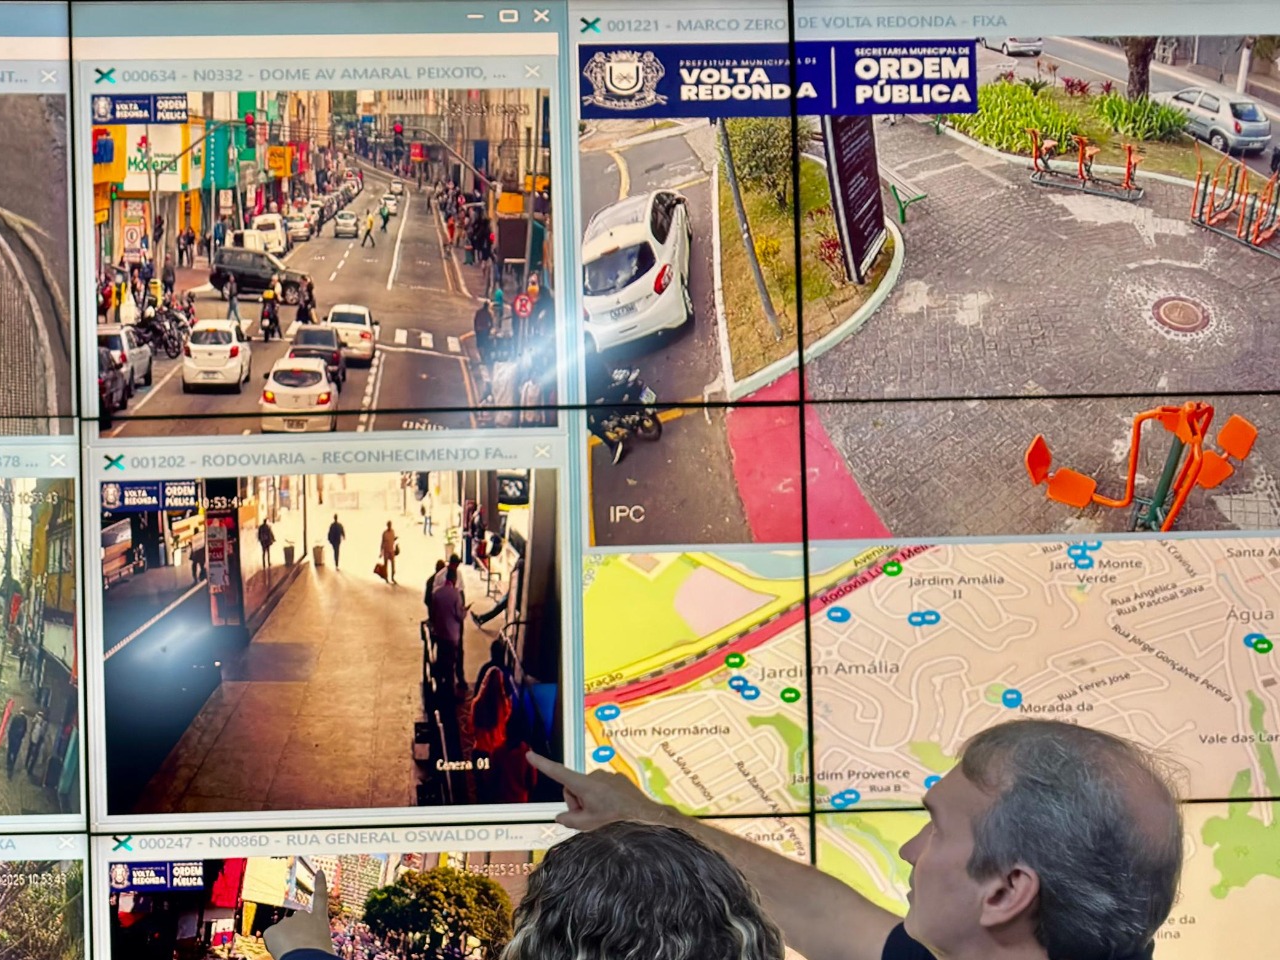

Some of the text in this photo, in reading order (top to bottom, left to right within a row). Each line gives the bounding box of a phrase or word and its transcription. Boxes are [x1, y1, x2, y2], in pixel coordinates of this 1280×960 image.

[607, 15, 1007, 32] 001221 MARCO ZERO DE VOLTA REDONDA FIXA
[855, 46, 970, 57] SECRETARIA MUNICIPAL DE
[122, 66, 487, 83] 000634 N0332 DOME AV AMARAL PEIXOTO,
[679, 67, 770, 84] VOLTA
[854, 57, 970, 80] ORDEM
[679, 82, 818, 101] REDONDA
[855, 78, 971, 105] PÚBLICA
[131, 455, 185, 469] 001202
[202, 453, 306, 468] RODOVIARIA
[322, 448, 480, 464] RECONHECIMENTO
[609, 504, 645, 524] IPC
[1226, 547, 1265, 558] Santa
[1098, 559, 1143, 569] Monte
[908, 574, 1005, 589] Jardim Amália
[1077, 574, 1117, 584] Verde
[820, 575, 869, 606] Rodovia
[1110, 580, 1178, 607] Rua Angélica
[1116, 583, 1205, 617] Rua Pascoal Silva
[1226, 604, 1275, 625] Água
[759, 660, 900, 682] Jardim Amália
[1111, 623, 1234, 703] Rua Jorge Gonçalves Pereira
[1056, 671, 1131, 702] Rua Feres José
[1020, 701, 1094, 714] Morada da
[650, 723, 731, 737] Normândia
[1199, 732, 1255, 744] Vale das
[661, 741, 676, 758] Rua
[476, 757, 490, 770] 01
[735, 760, 750, 778] Rua
[792, 767, 911, 786] Jardim Provence
[869, 784, 891, 794] Rua
[139, 837, 193, 850] 000247
[209, 835, 270, 849] N0086D
[286, 834, 320, 847] RUA
[325, 831, 400, 846] GENERAL
[405, 828, 490, 843] OSWALDO
[1179, 914, 1196, 925] da
